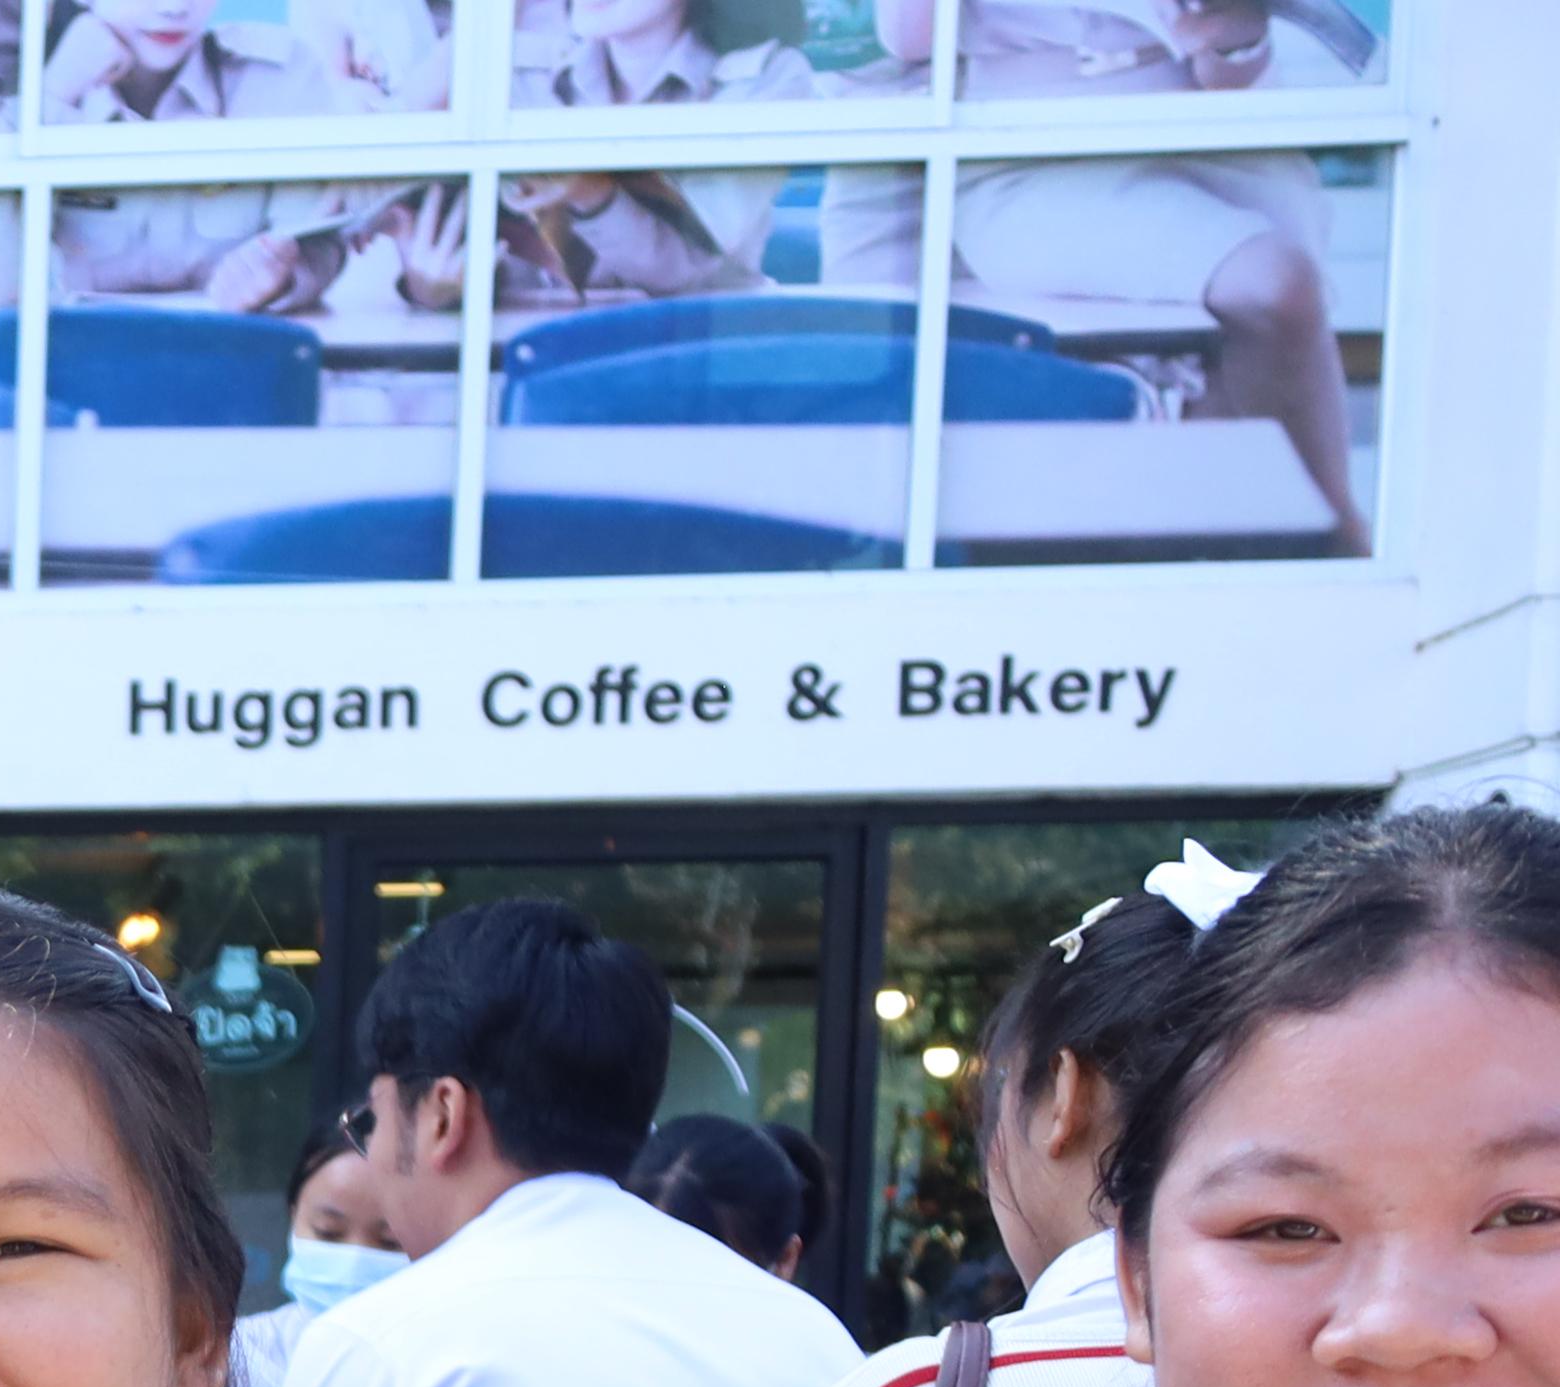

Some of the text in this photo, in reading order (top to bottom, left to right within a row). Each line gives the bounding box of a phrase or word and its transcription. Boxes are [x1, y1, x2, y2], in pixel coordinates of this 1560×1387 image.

[129, 654, 1177, 751] Huggan Coffee & Bakery
